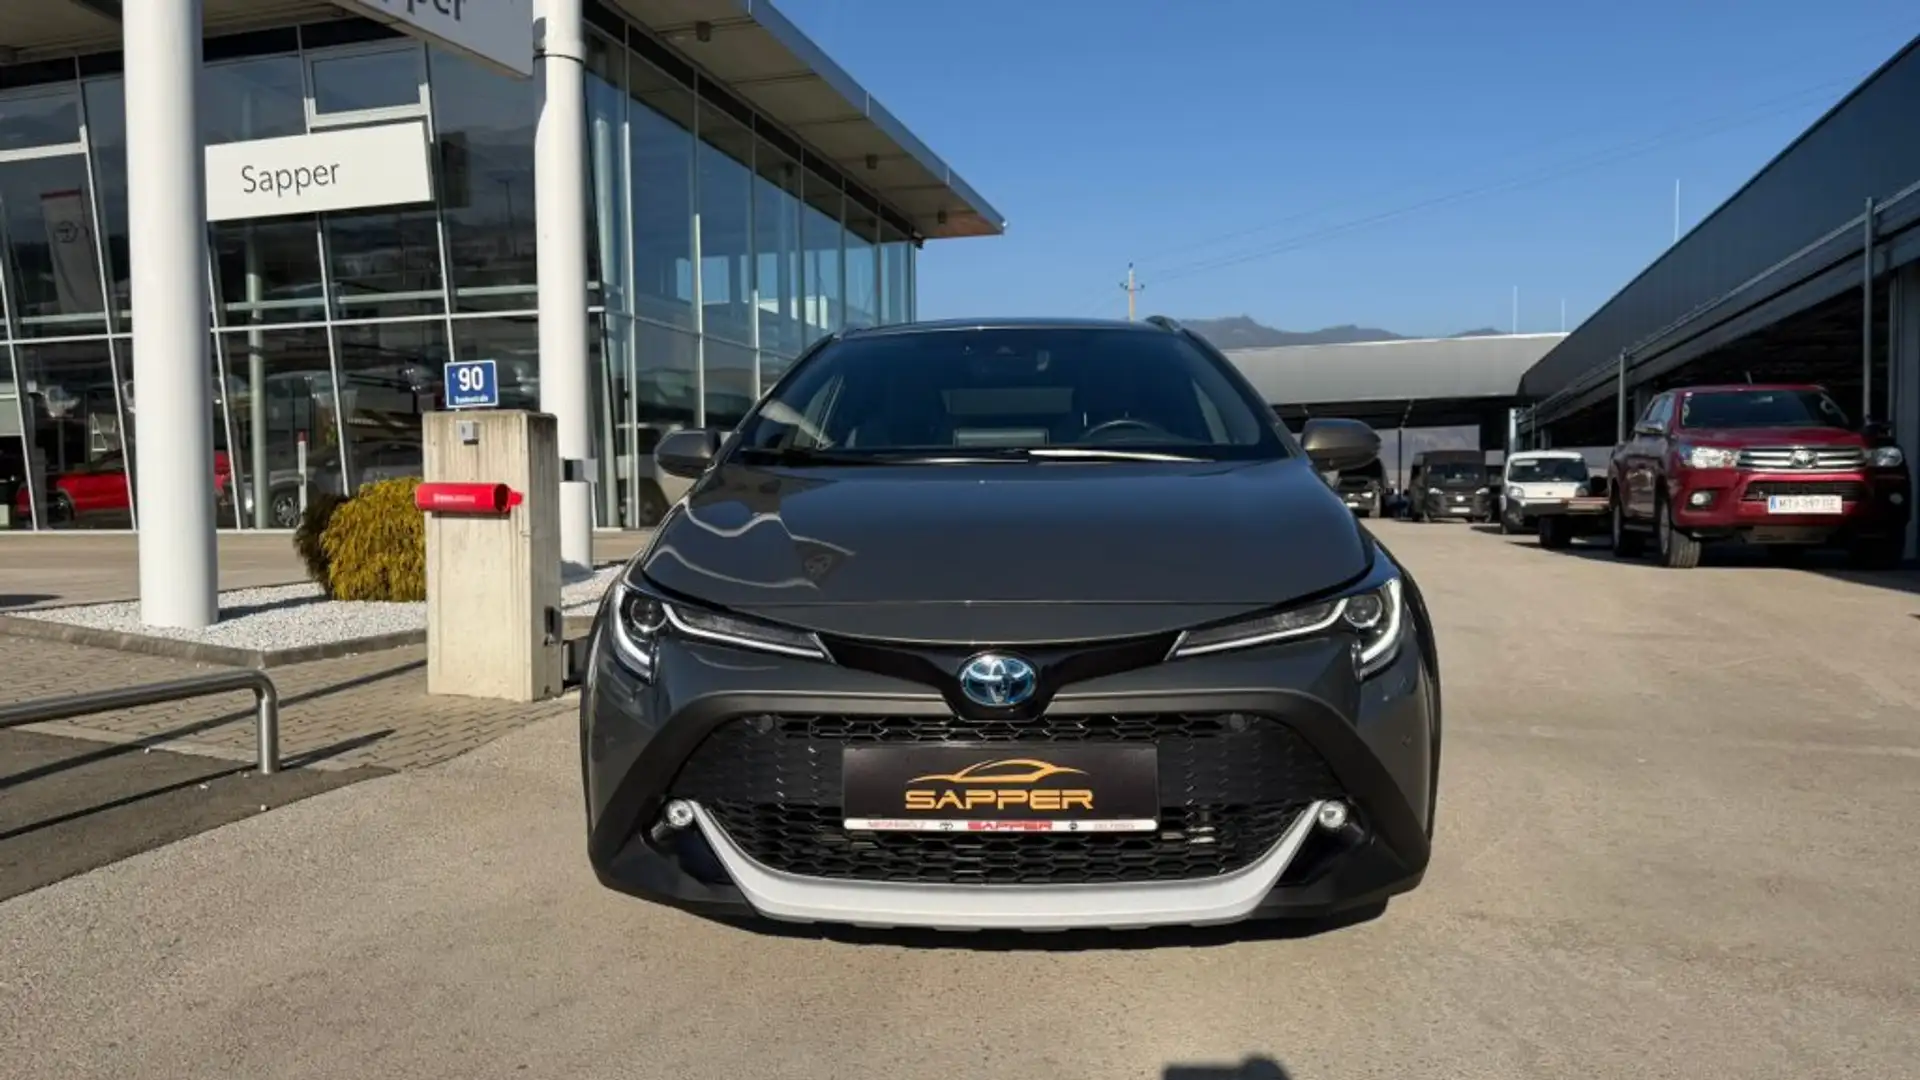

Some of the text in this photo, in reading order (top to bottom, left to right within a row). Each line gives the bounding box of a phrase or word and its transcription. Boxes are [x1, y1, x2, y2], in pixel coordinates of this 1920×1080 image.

[241, 162, 341, 197] Sapper
[458, 366, 484, 391] 90
[905, 789, 1095, 810] SAPPER
